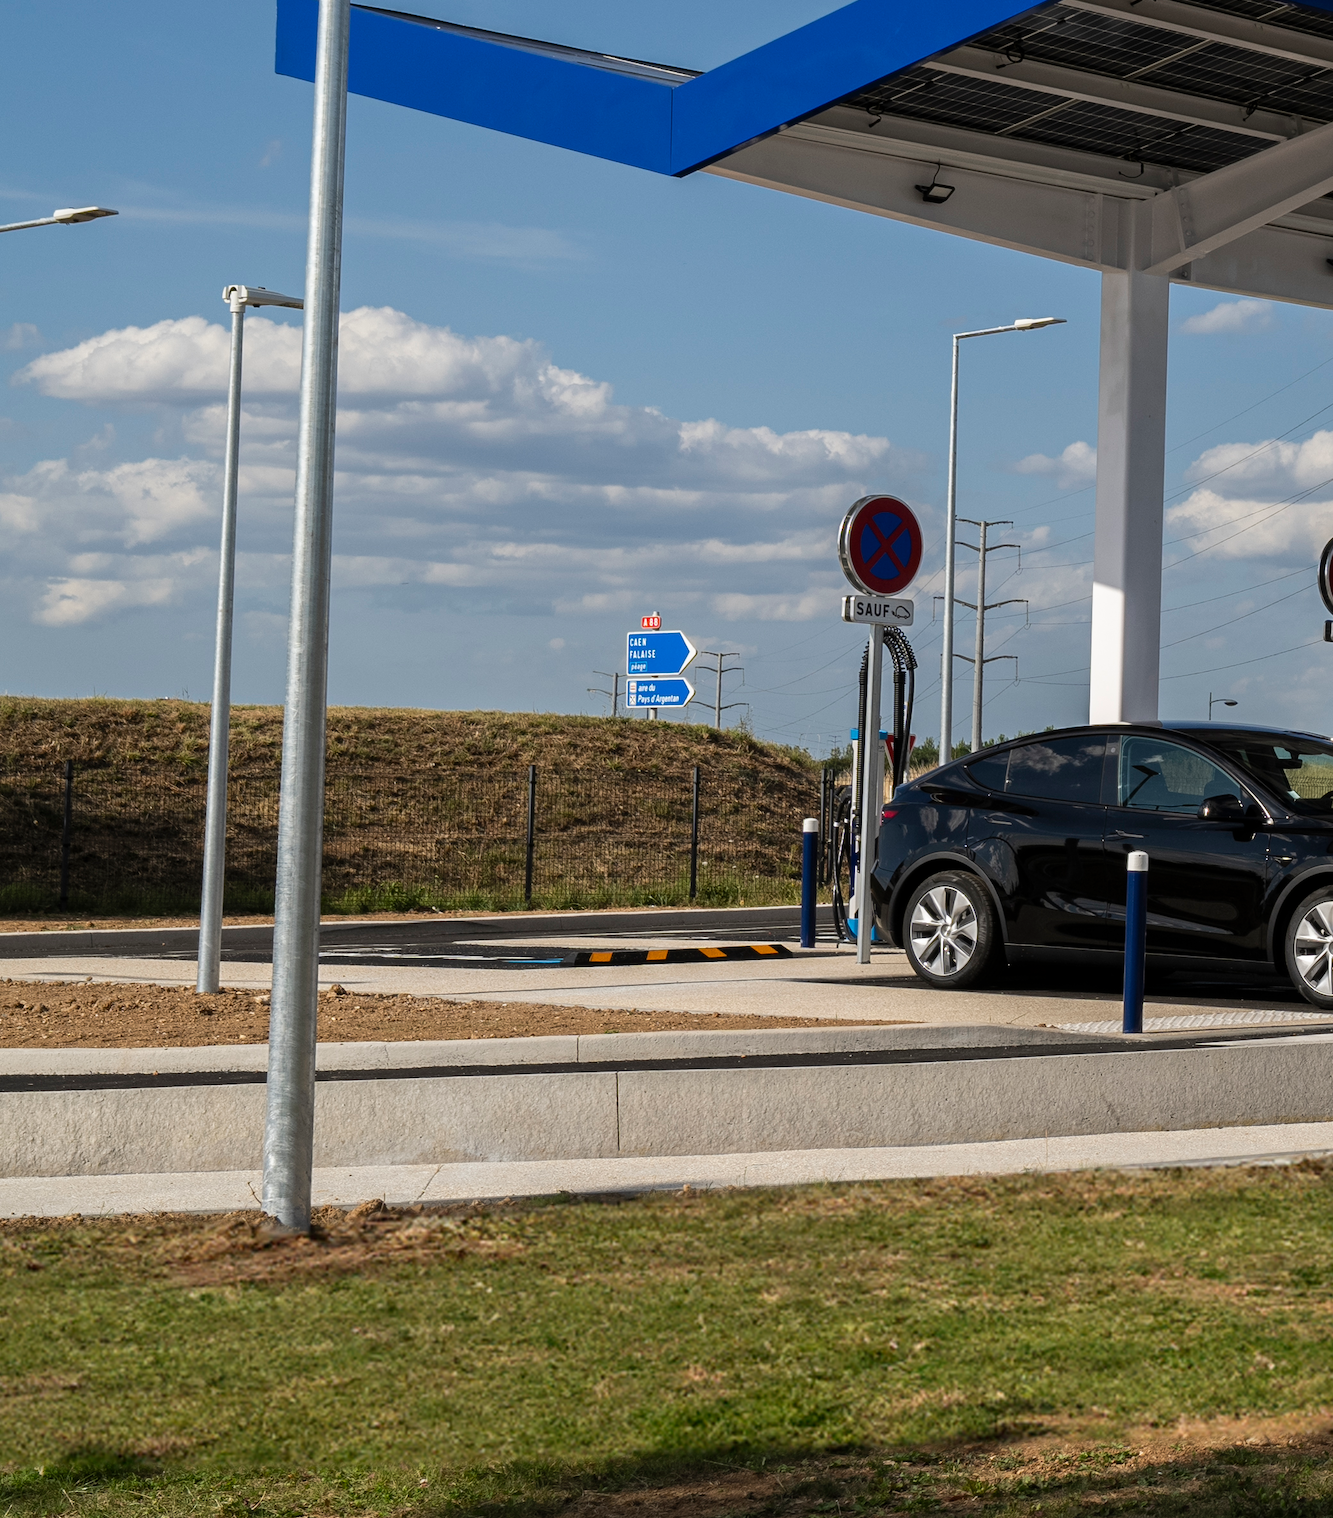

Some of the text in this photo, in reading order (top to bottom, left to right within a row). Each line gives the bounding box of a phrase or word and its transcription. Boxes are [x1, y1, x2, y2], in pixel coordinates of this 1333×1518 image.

[856, 601, 891, 618] SAUF
[630, 638, 647, 646] CAEN
[630, 650, 656, 658] FALAISE
[638, 684, 656, 692] aire du
[638, 695, 650, 704] Pays
